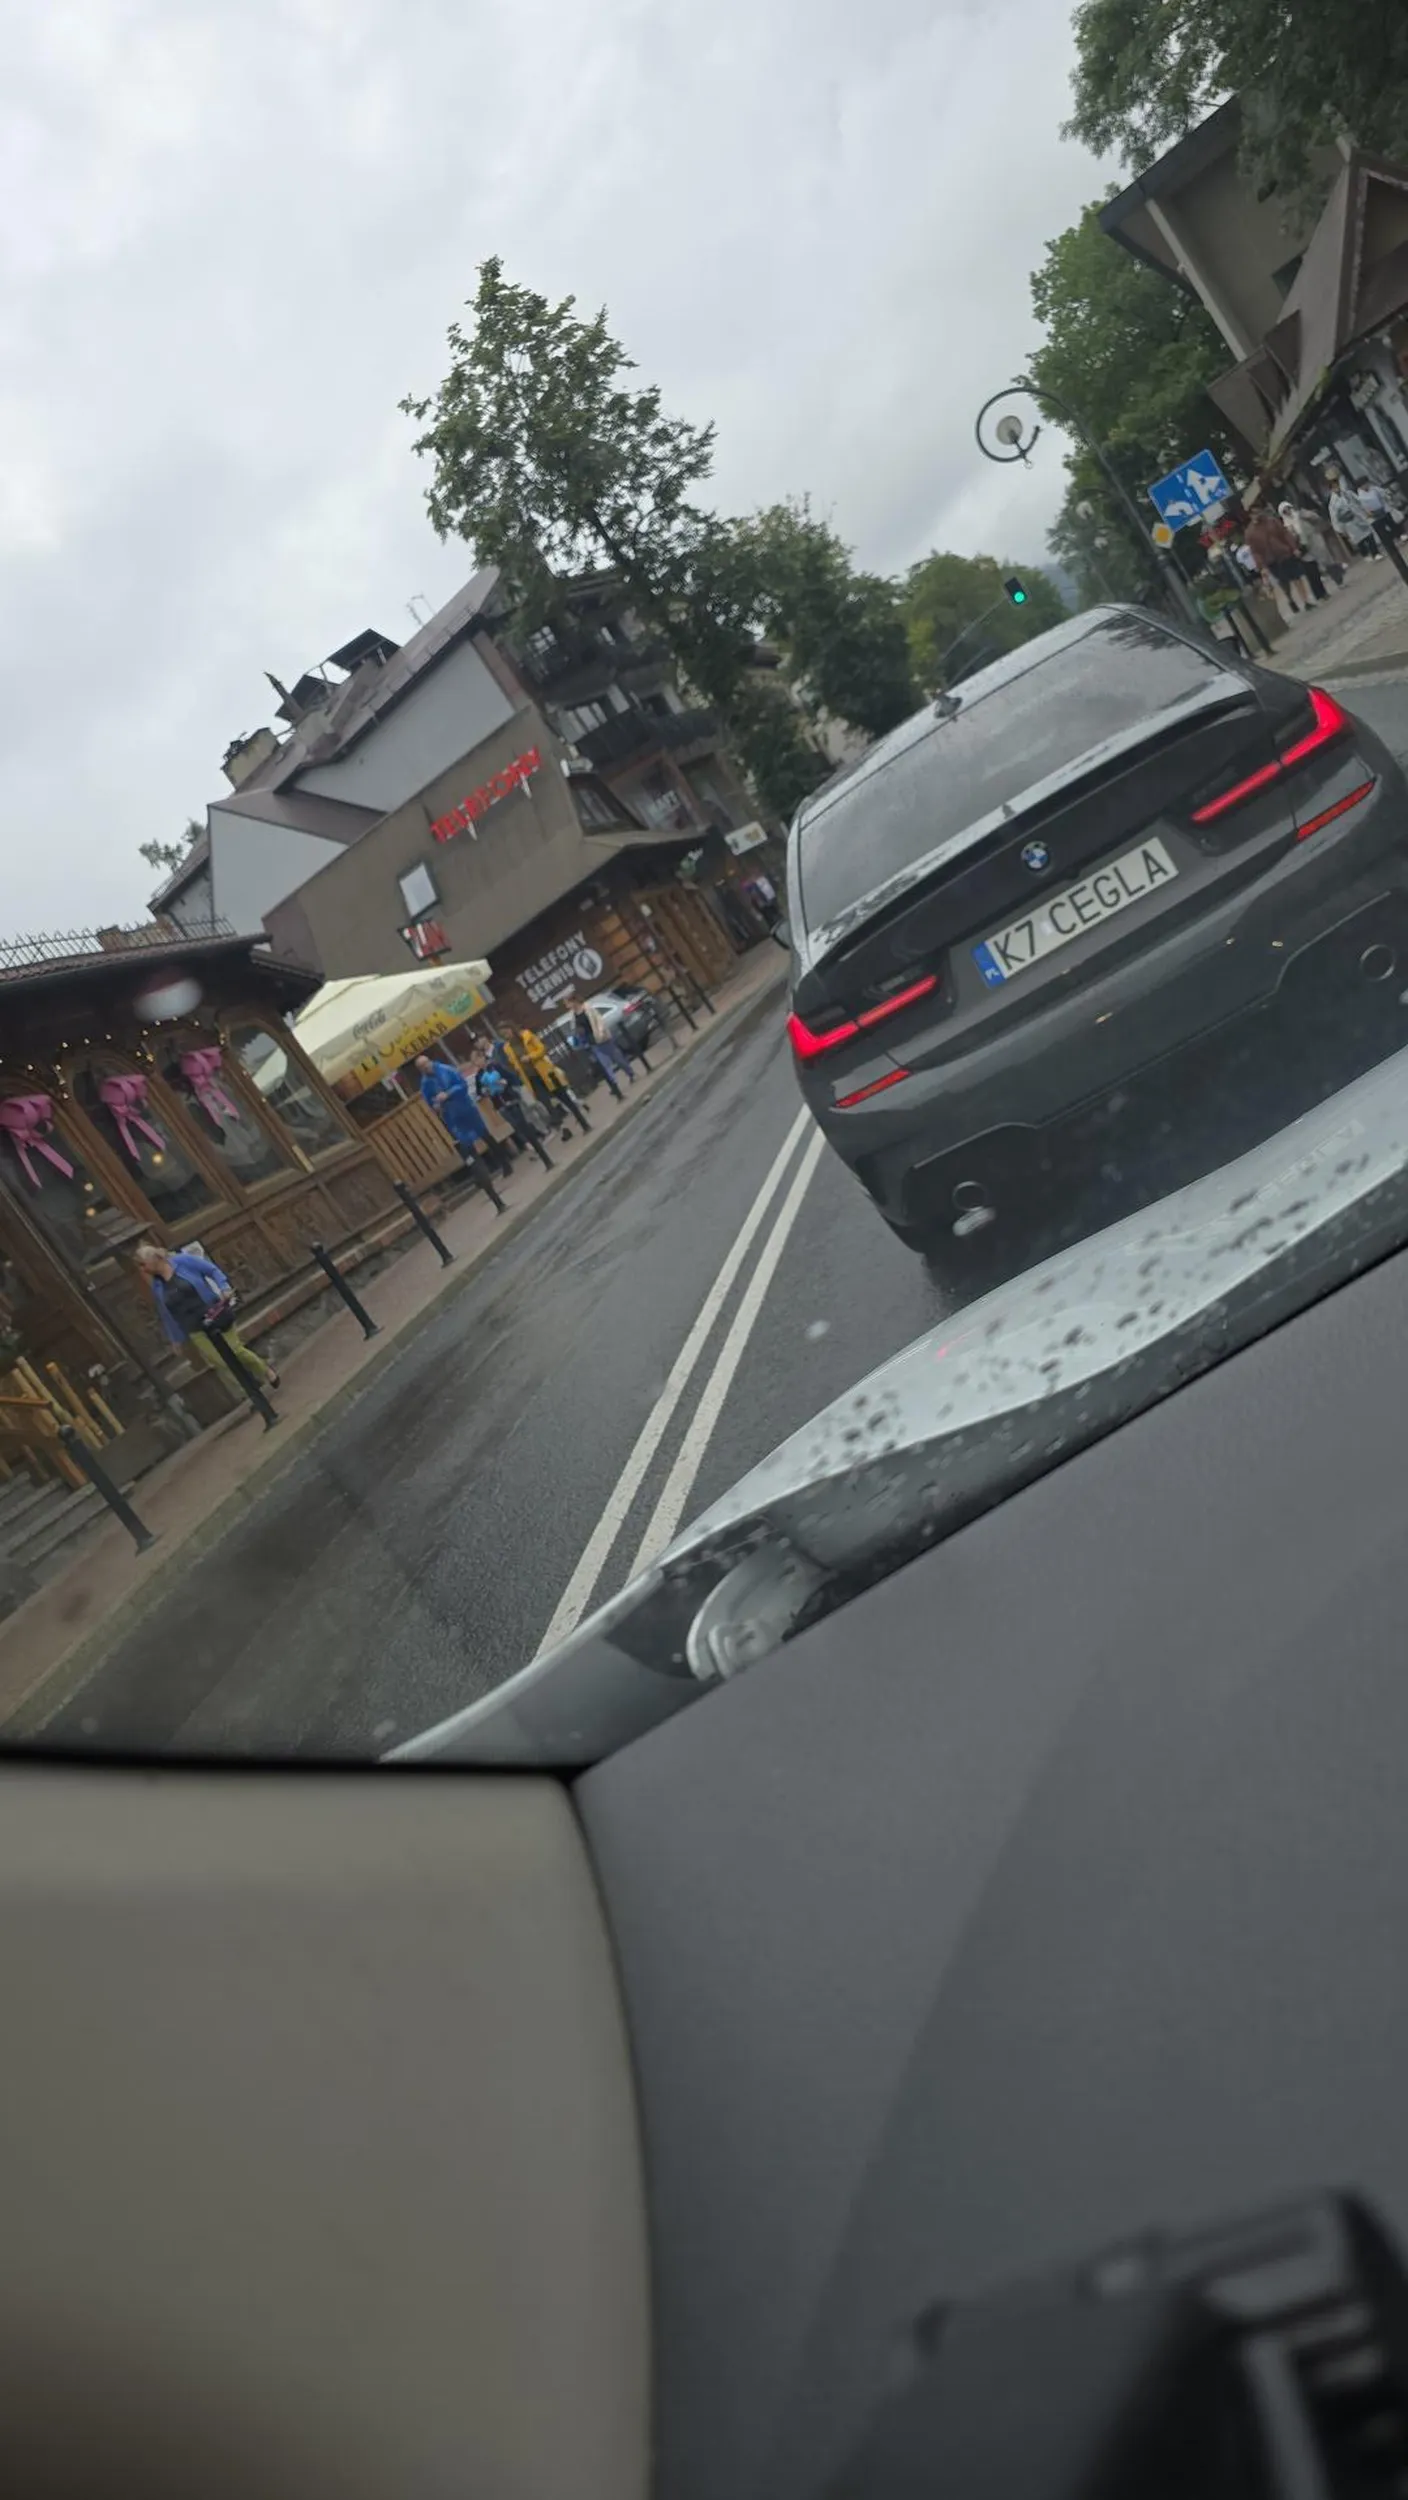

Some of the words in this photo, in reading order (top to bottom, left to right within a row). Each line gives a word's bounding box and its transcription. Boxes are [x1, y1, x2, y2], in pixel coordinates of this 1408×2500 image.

[993, 919, 1036, 971] K7
[1048, 848, 1169, 935] CEGLA
[515, 930, 586, 988] TELEFONY
[526, 962, 574, 1003] SERWIS
[400, 1021, 448, 1059] KEBAB
